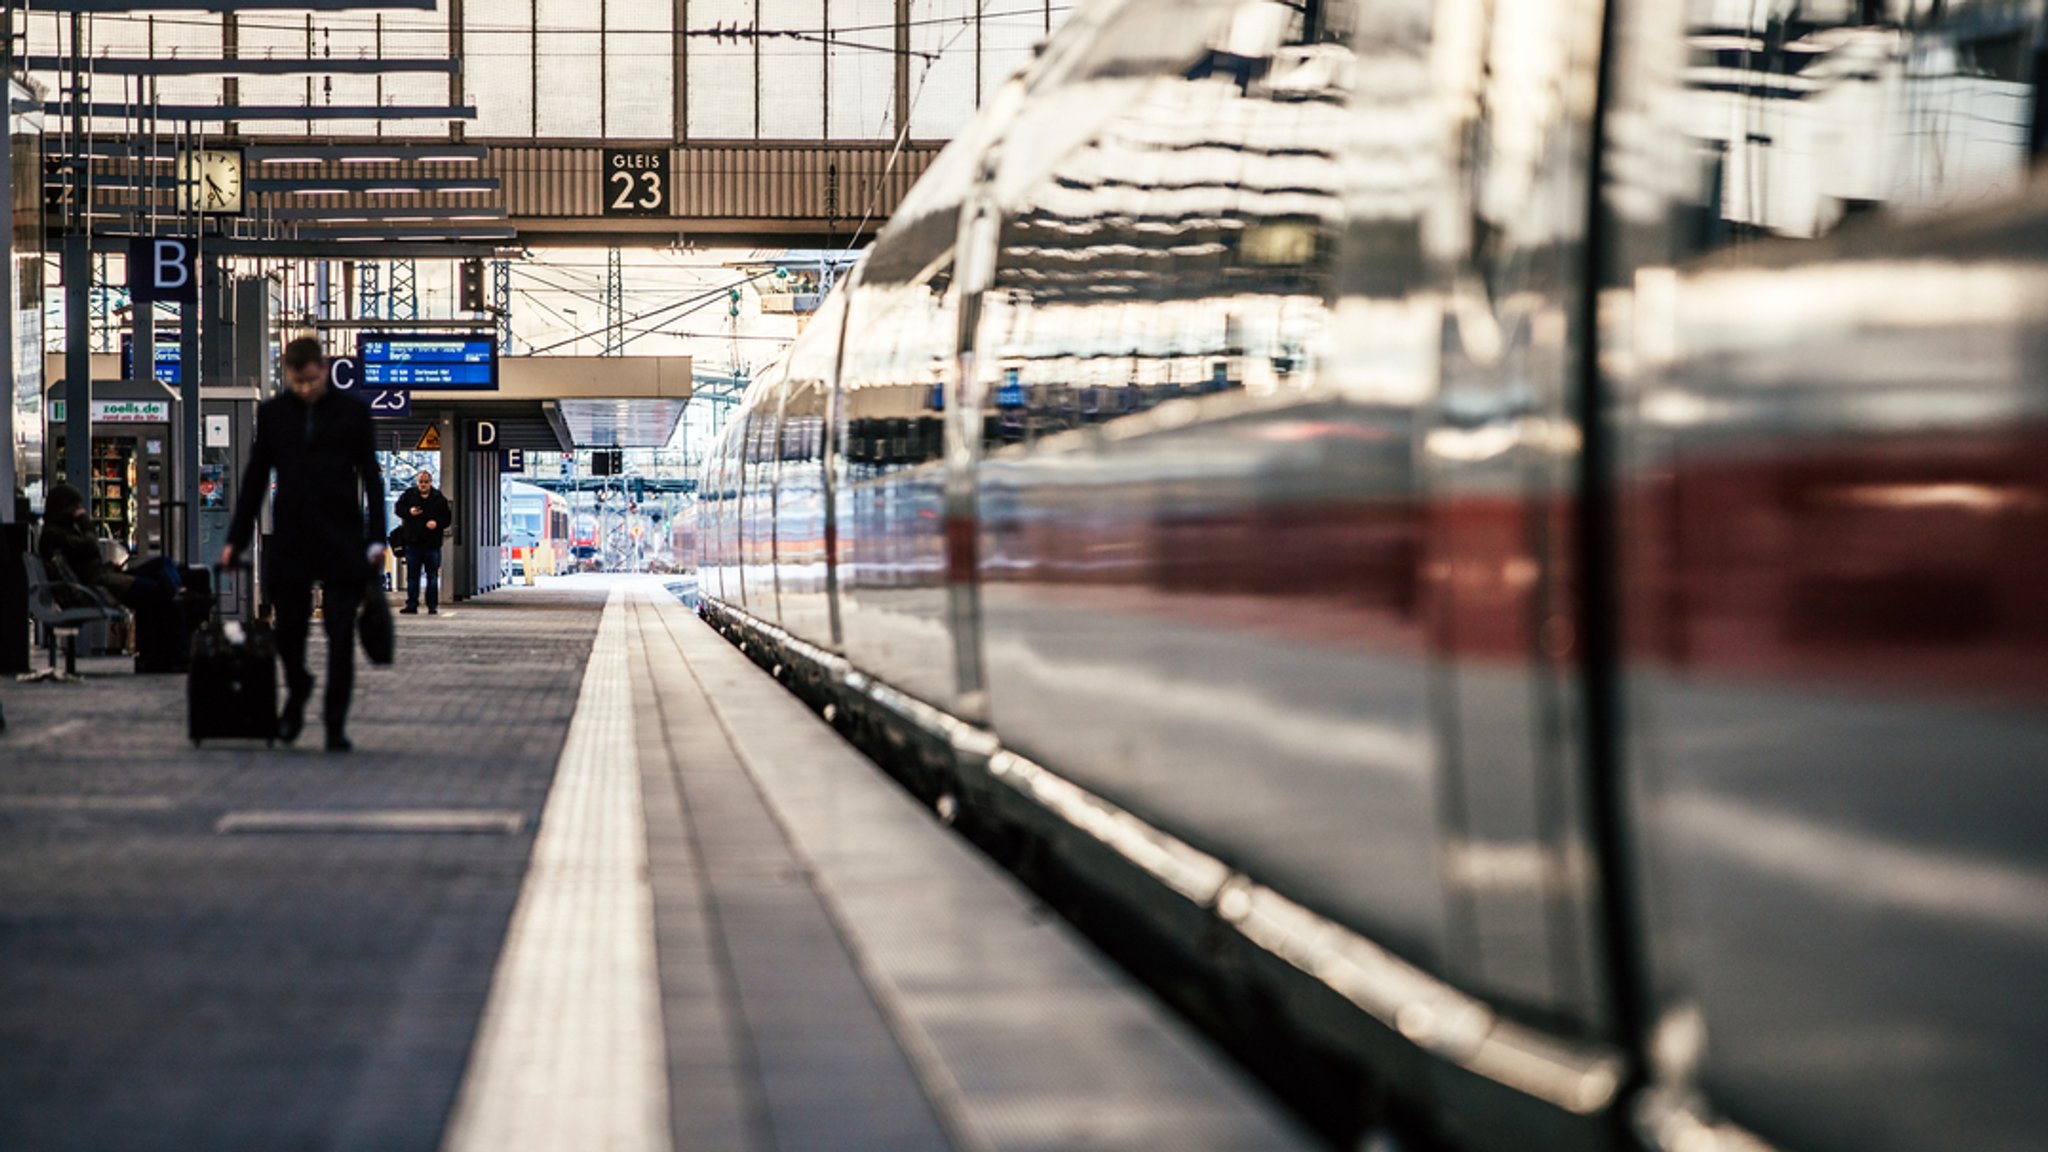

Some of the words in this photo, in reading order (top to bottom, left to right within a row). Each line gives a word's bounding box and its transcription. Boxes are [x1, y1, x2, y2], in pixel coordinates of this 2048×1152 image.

[612, 154, 660, 168] GLEIS
[610, 170, 662, 209] 23
[154, 239, 188, 288] B
[331, 358, 355, 389] C
[103, 402, 160, 413] zoells.de
[370, 390, 406, 410] 23
[477, 422, 496, 445] D
[508, 449, 521, 468] E
